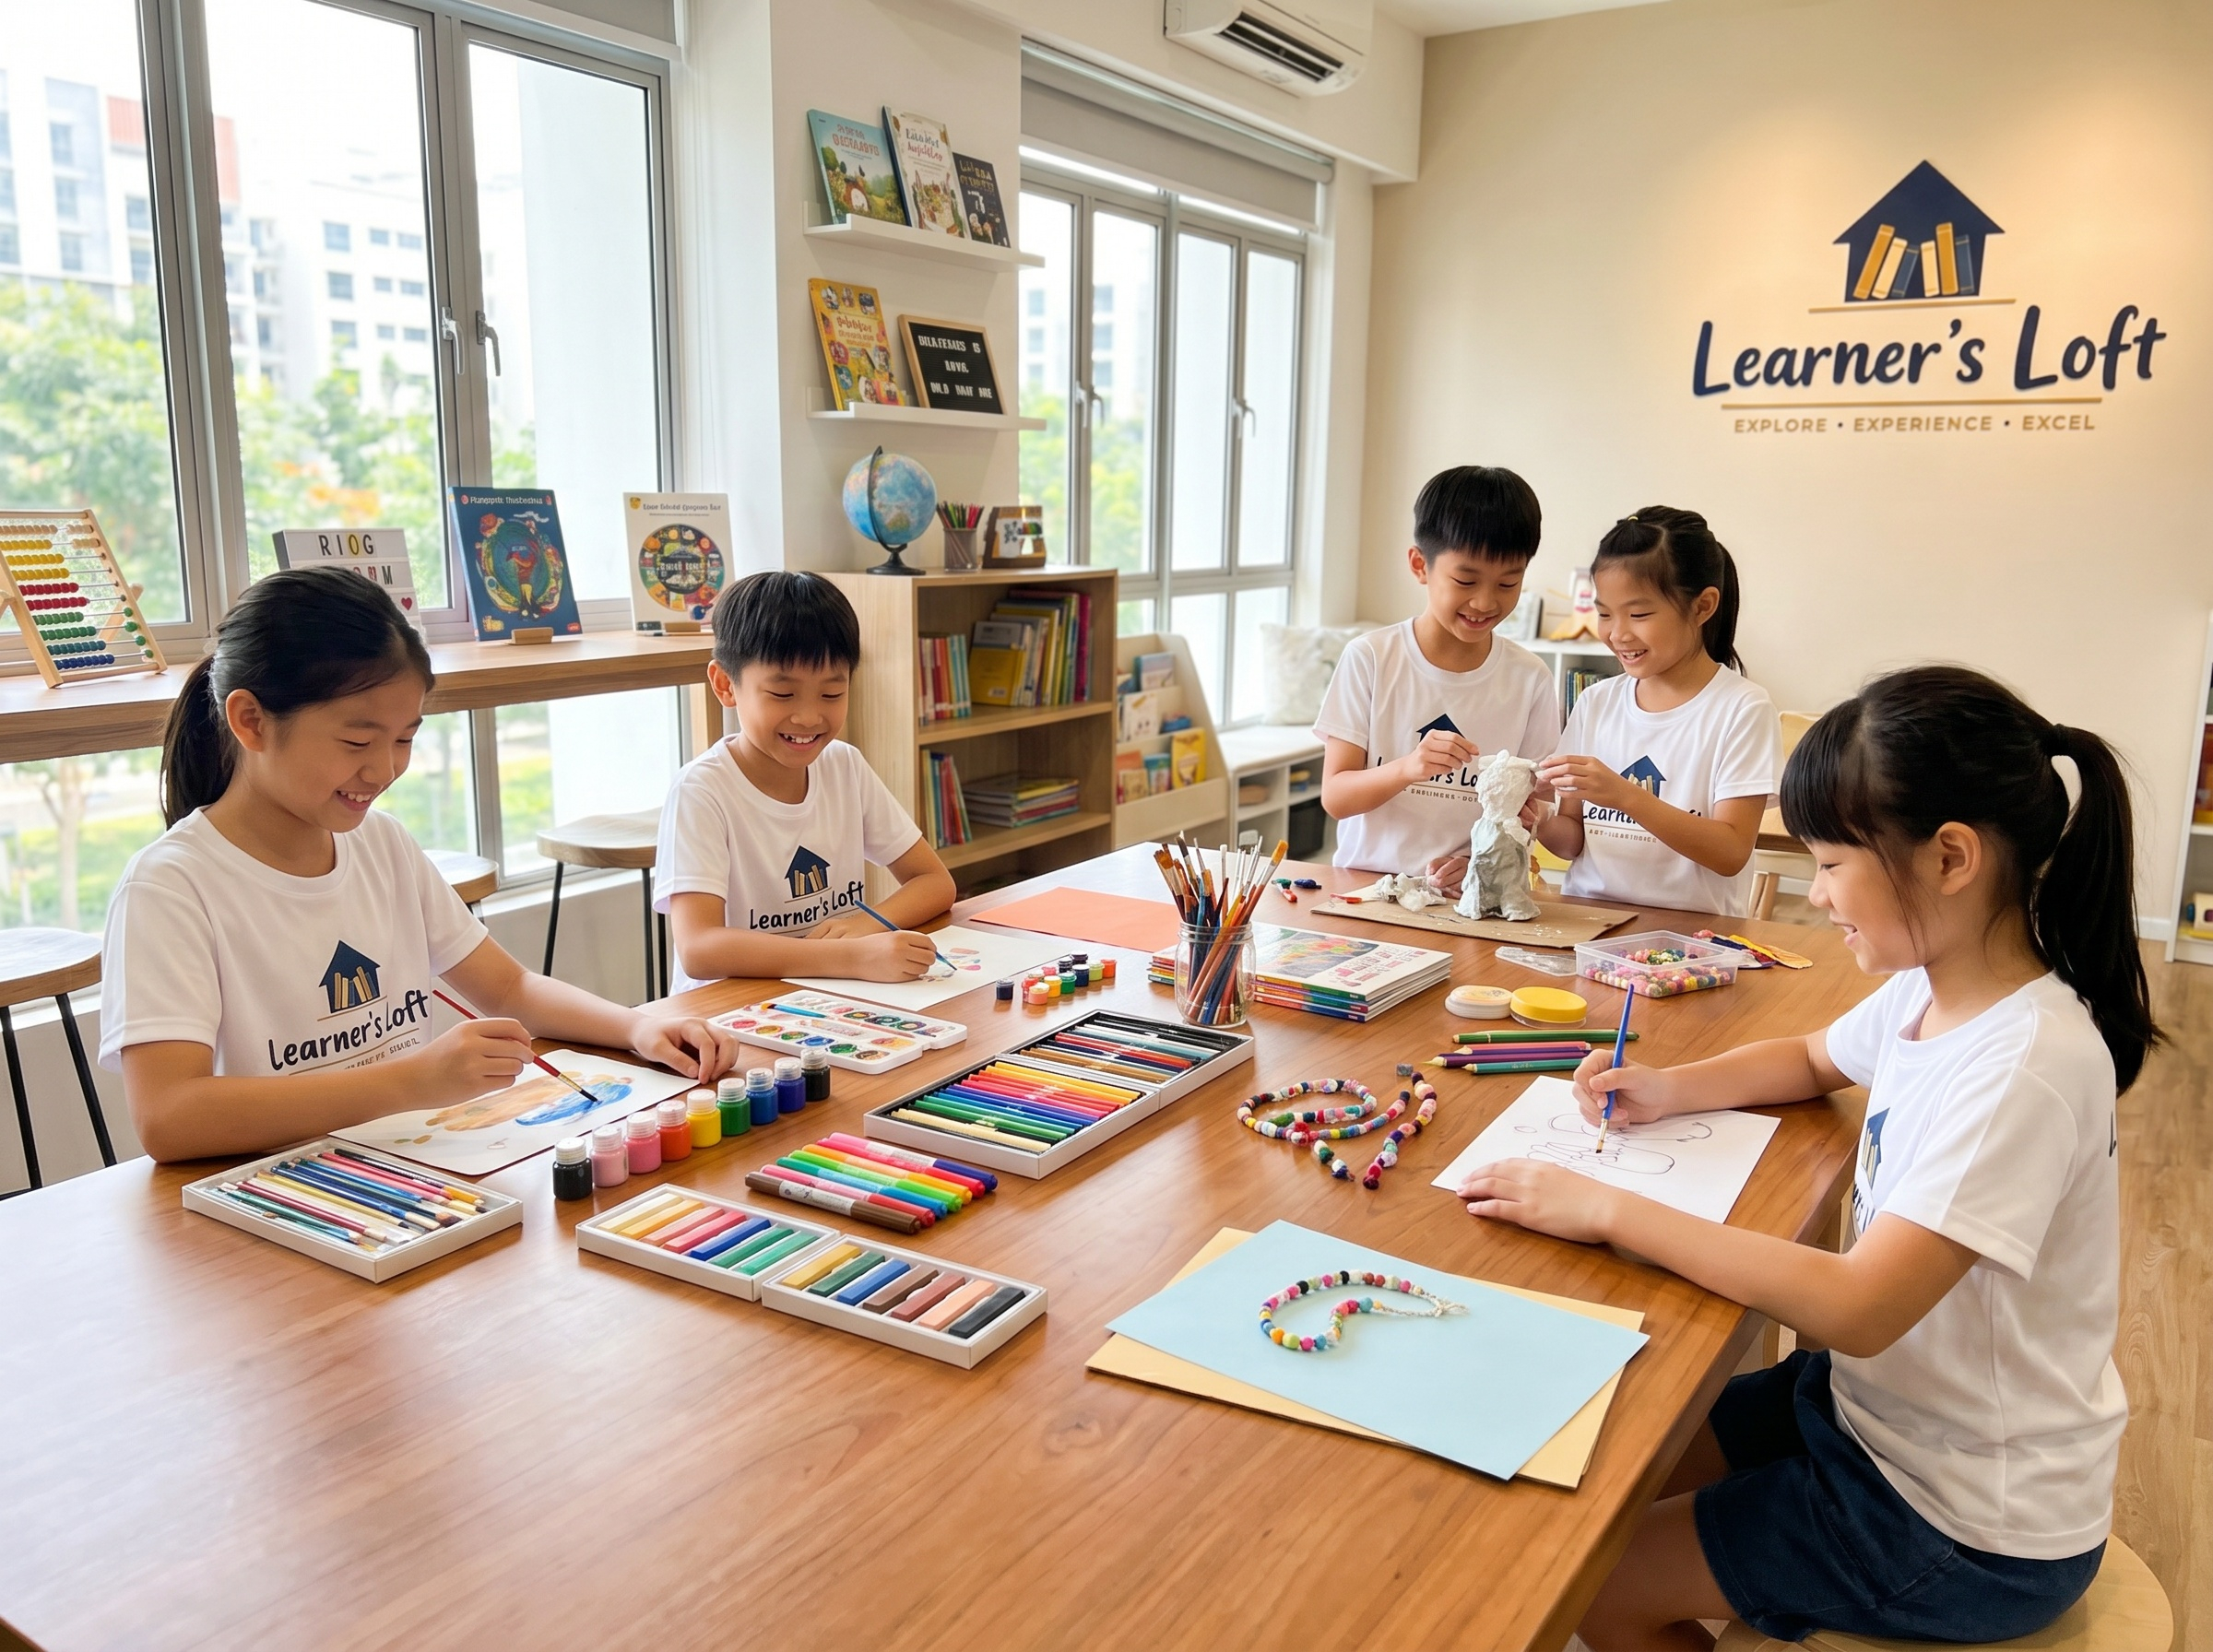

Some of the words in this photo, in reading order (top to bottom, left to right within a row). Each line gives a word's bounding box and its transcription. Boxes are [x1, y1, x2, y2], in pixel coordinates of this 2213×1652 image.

[1693, 319, 1984, 395] Learner's
[2015, 305, 2166, 391] Loft
[1734, 419, 1828, 432] EXPLORE
[1852, 417, 1992, 431] EXPERIENCE
[2022, 415, 2095, 431] EXCEL
[318, 535, 373, 556] RIOG
[750, 897, 829, 929] Learner's
[832, 881, 864, 910] Loft
[268, 1011, 383, 1070] Learner's
[385, 990, 428, 1032] Loft
